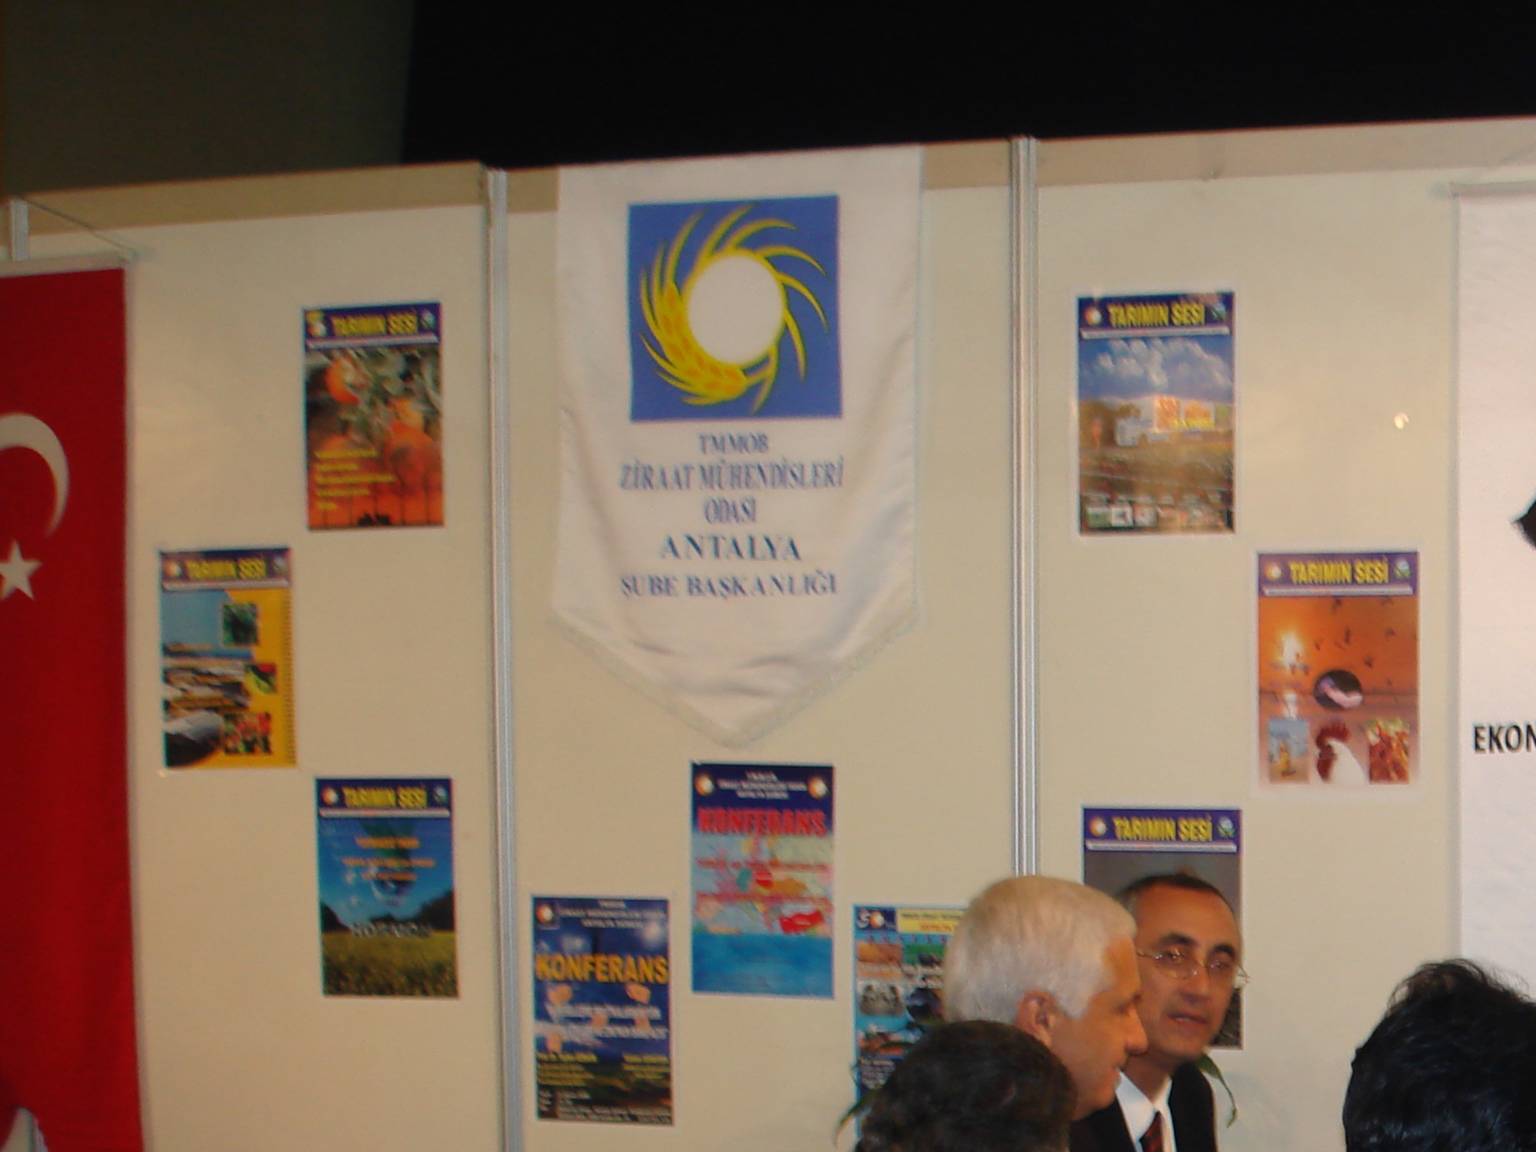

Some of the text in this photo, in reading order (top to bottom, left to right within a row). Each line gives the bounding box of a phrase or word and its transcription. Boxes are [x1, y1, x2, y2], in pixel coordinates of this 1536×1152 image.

[1108, 303, 1169, 328] TARIMIN
[698, 433, 769, 454] TMMOB
[620, 455, 844, 491] ZİRAAT MÜHENDİSLERİ
[659, 534, 802, 561] ANTALYA
[686, 569, 838, 599] BAŞKANLIĞI
[1290, 561, 1351, 584] TARIMIN
[1112, 815, 1178, 841] TARIMIN
[535, 952, 670, 986] KONFERANS
